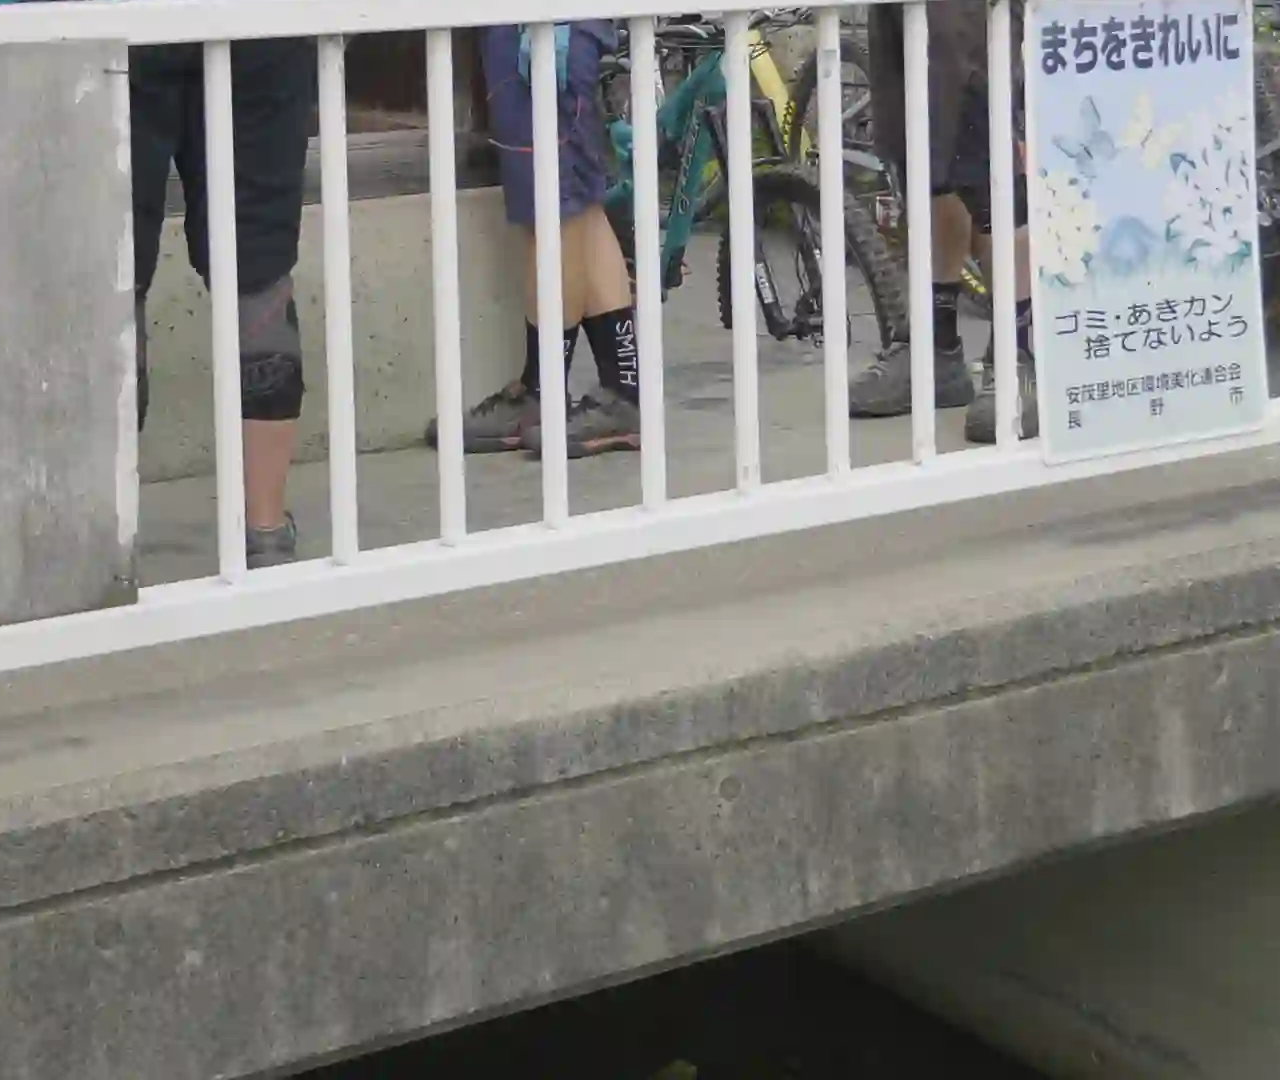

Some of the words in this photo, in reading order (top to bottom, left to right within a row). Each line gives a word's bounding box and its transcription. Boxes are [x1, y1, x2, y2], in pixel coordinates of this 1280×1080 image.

[1039, 12, 1241, 77] まちをきれいに
[615, 319, 638, 386] SMITH
[1083, 314, 1250, 362] 捨てないよう
